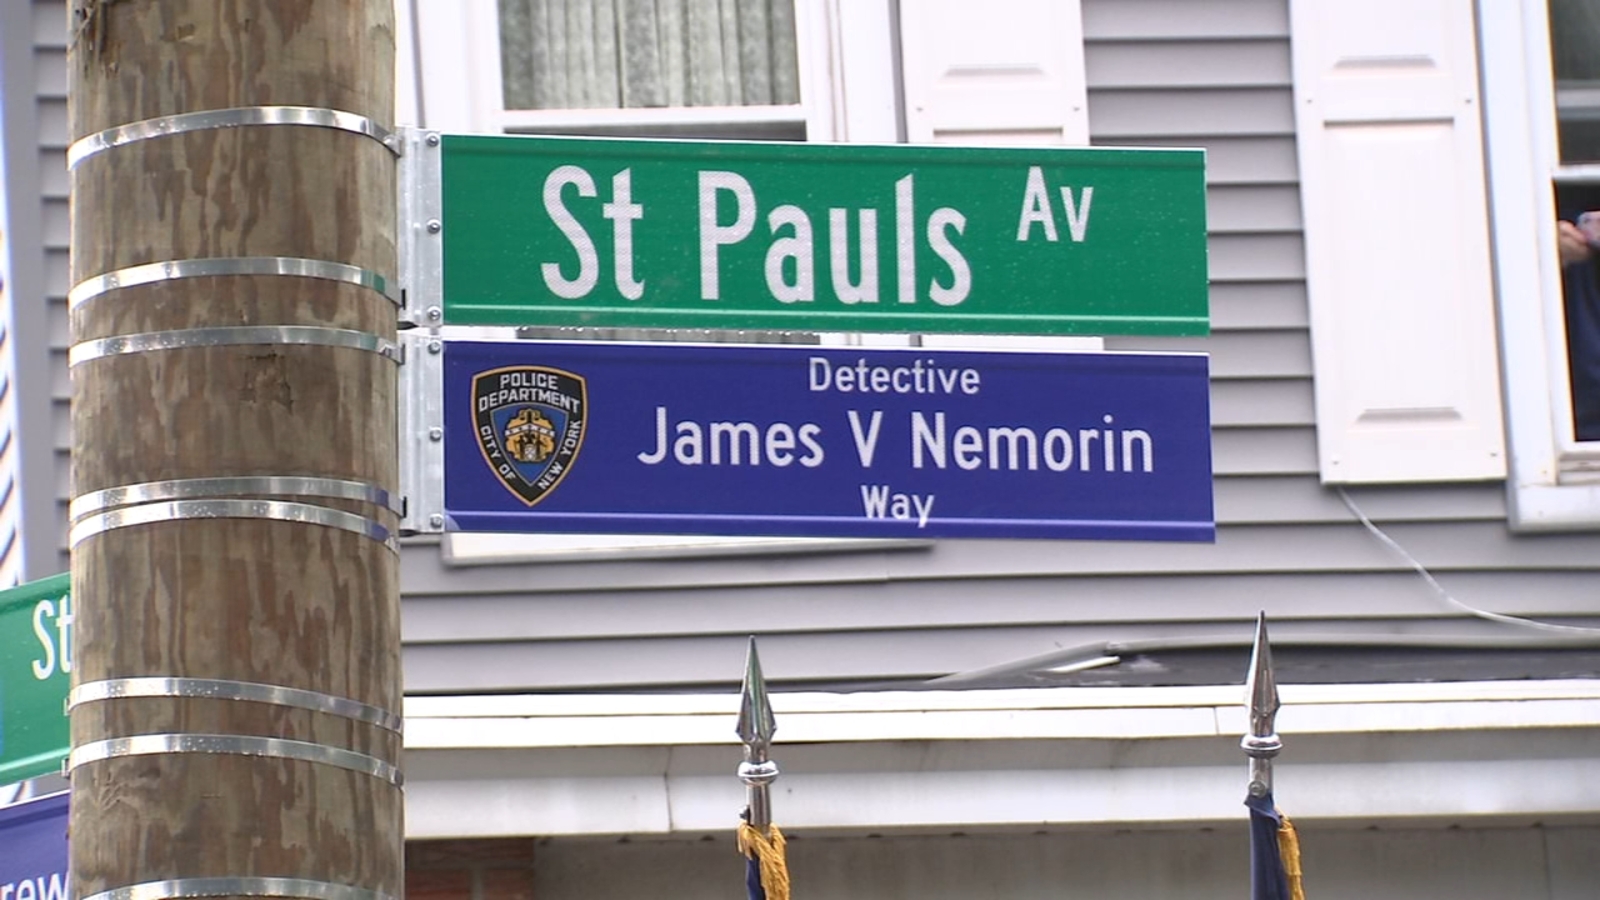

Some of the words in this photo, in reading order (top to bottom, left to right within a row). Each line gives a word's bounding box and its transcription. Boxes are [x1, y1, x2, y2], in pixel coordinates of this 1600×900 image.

[541, 165, 645, 300] St
[698, 171, 972, 306] Pauls
[1016, 166, 1094, 242] Av
[500, 372, 558, 390] POLICE
[809, 358, 981, 394] Detective
[479, 388, 580, 413] DEPARTMENT
[480, 425, 501, 459] CITY
[498, 463, 516, 480] OF
[537, 461, 564, 490] NEW
[560, 420, 582, 456] YORK
[637, 407, 825, 467] James
[848, 411, 883, 467] V
[911, 411, 1154, 473] Nemorin
[861, 485, 935, 528] Way
